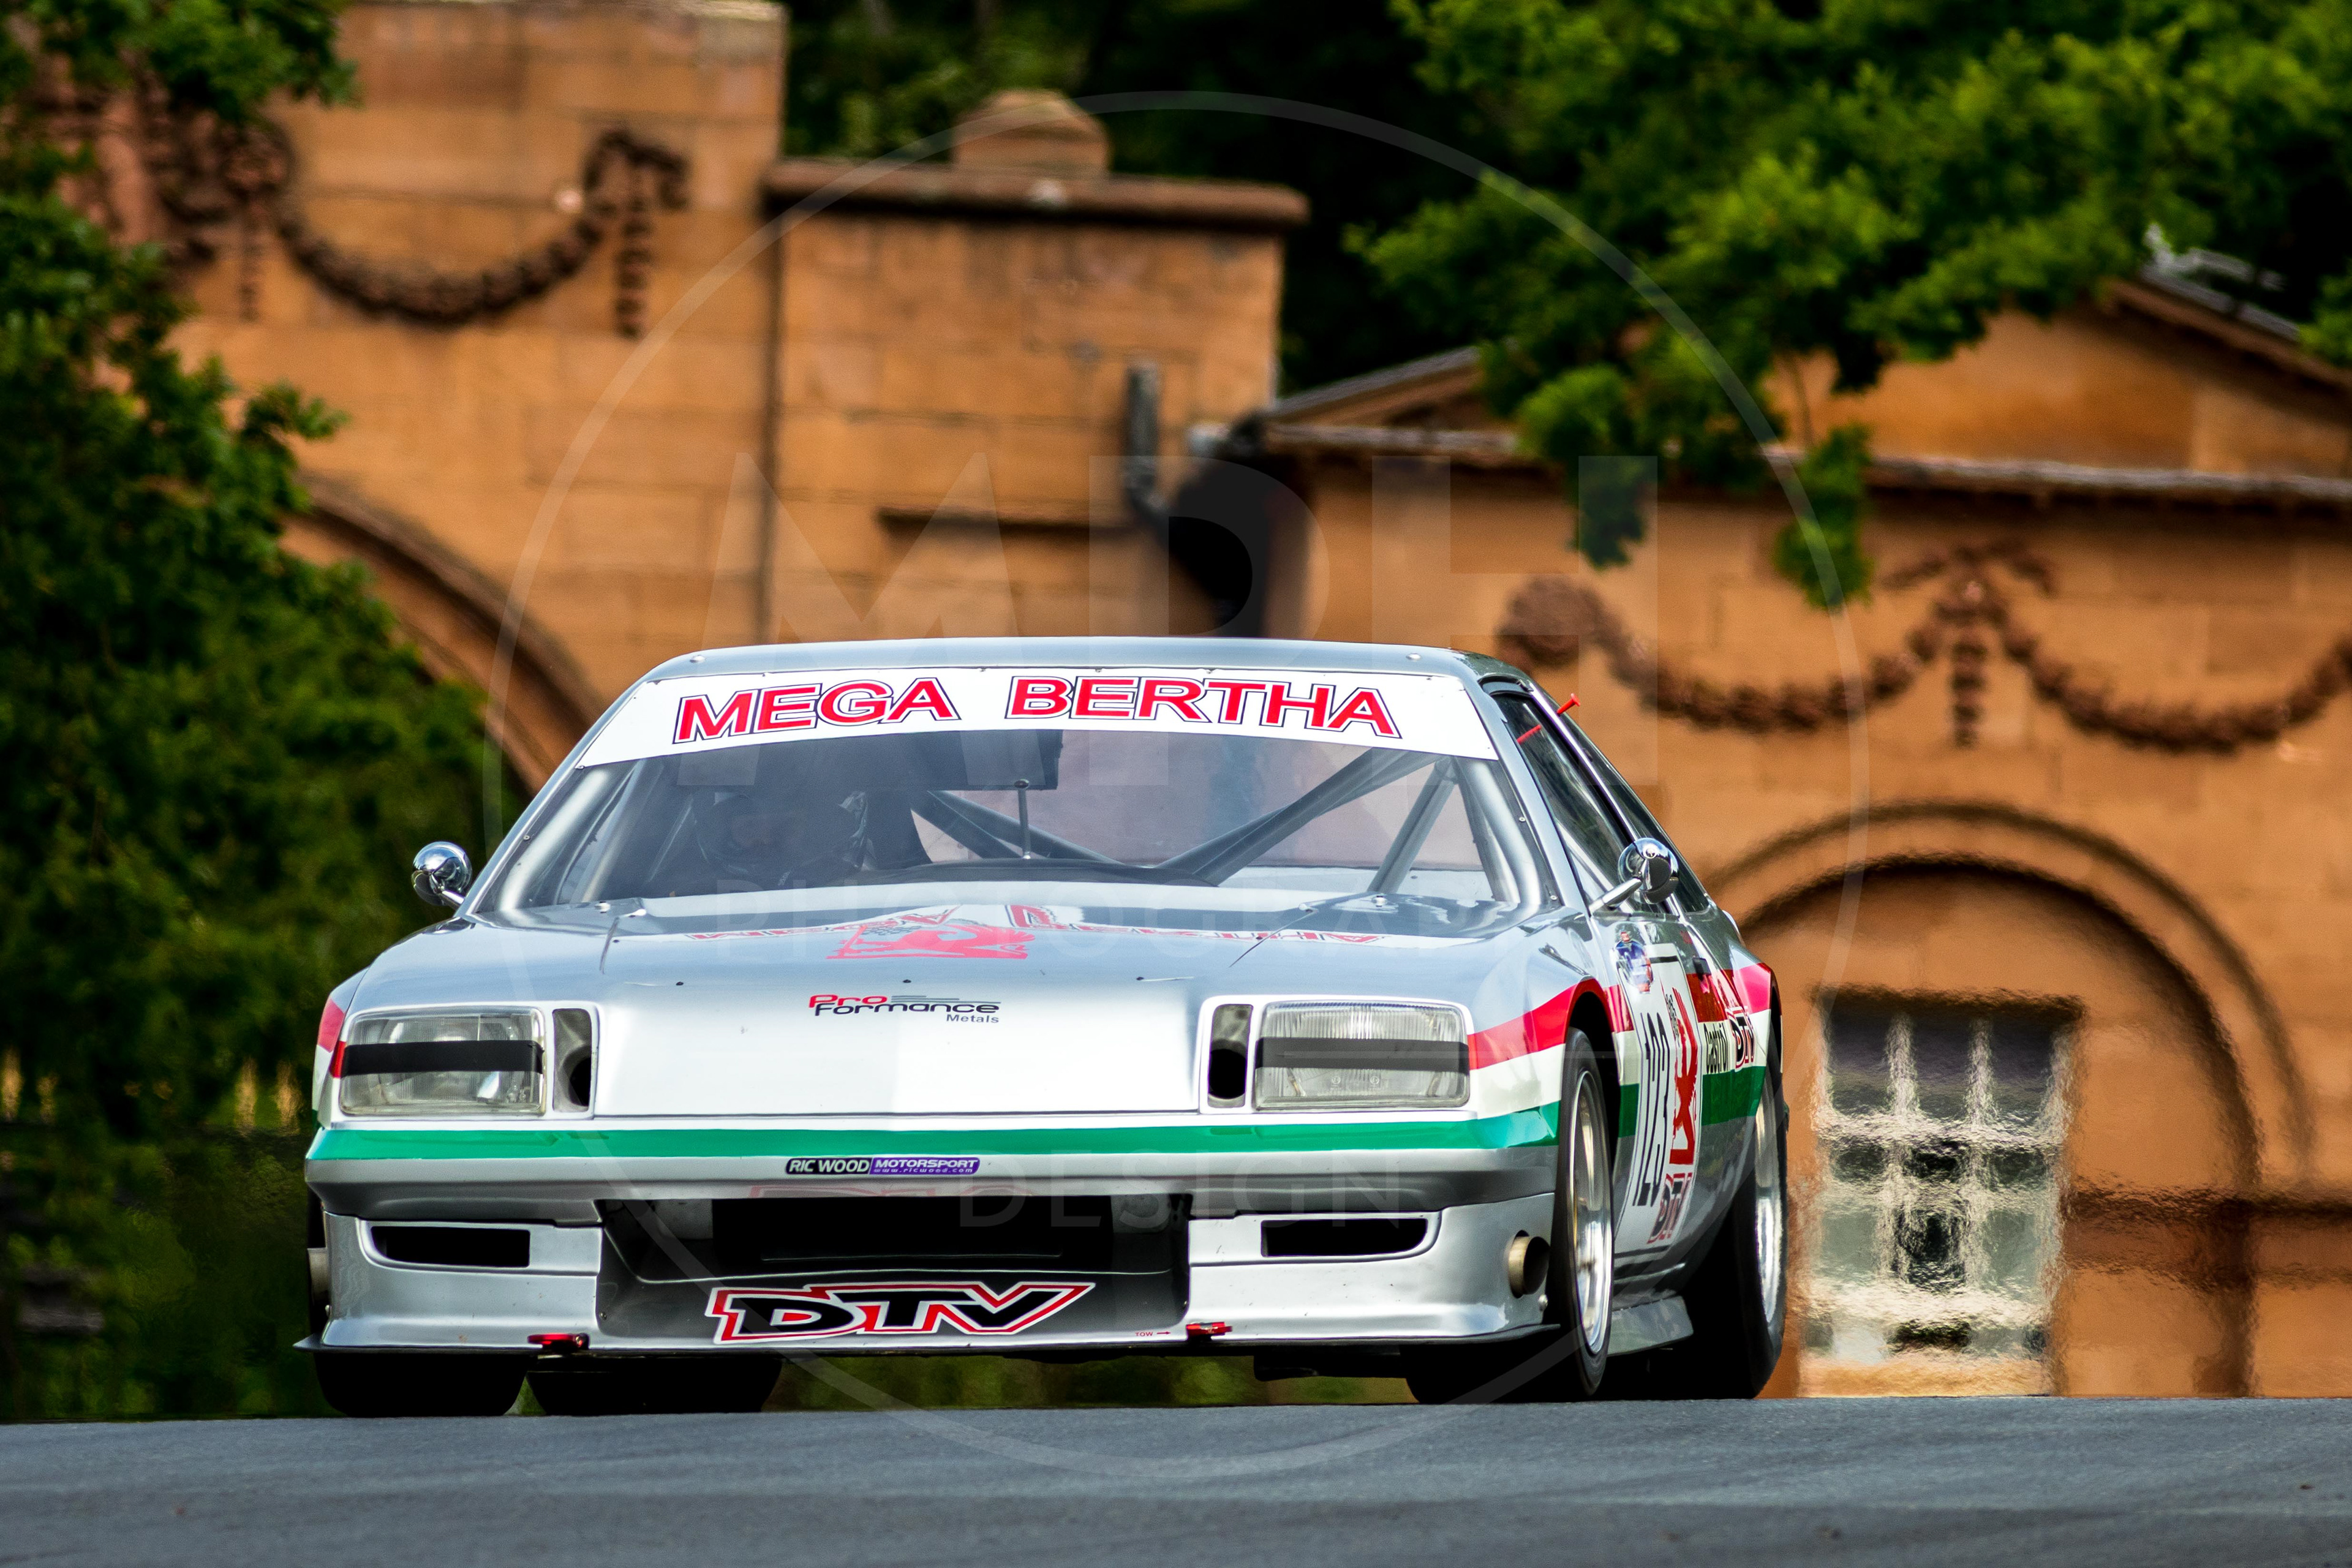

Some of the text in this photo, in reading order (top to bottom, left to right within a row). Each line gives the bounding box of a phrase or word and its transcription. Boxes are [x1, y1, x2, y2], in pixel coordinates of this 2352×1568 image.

[673, 676, 1403, 745] MEGA BERTHA
[809, 994, 888, 1008] Pro
[815, 1003, 1000, 1016] Formance
[946, 1014, 999, 1023] Metals
[1703, 1022, 1728, 1075] Castrol
[1632, 1012, 1671, 1208] 123
[789, 1159, 978, 1173] RIC WOOD MOTORSPORT
[704, 1282, 1096, 1344] DTV
